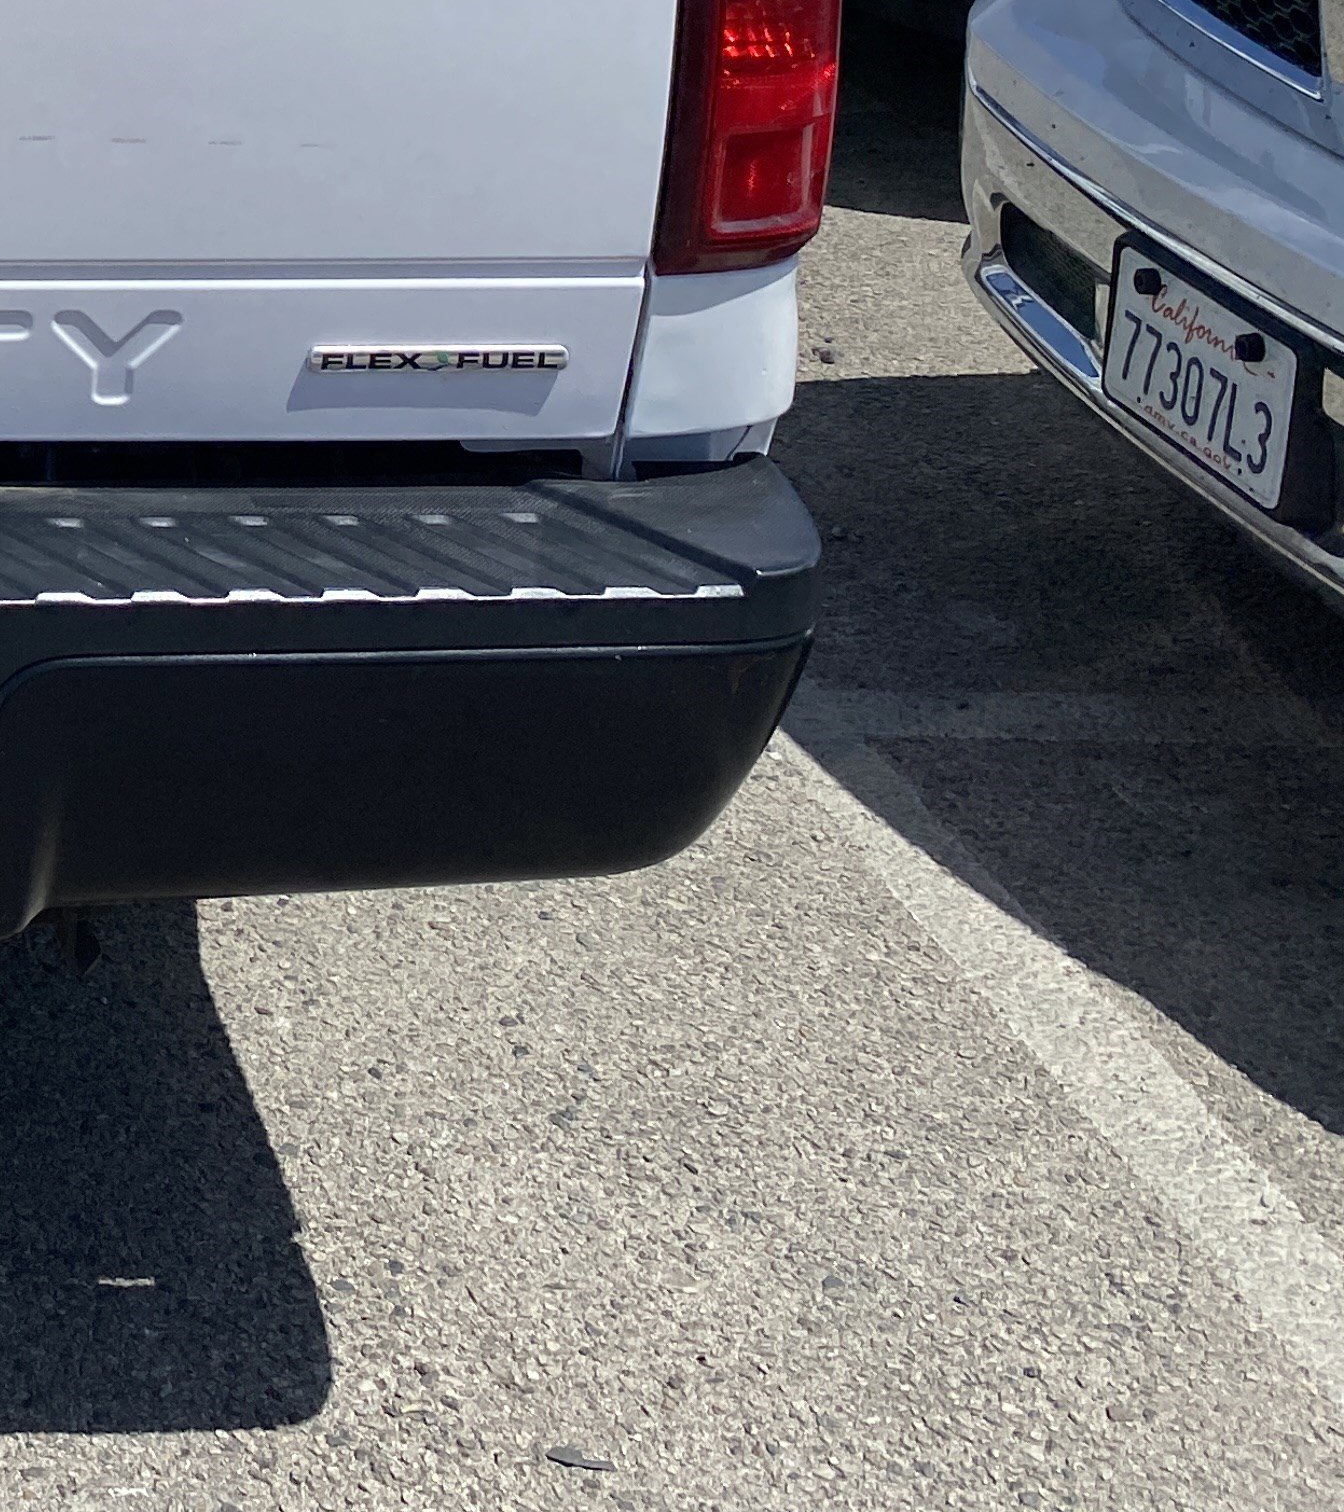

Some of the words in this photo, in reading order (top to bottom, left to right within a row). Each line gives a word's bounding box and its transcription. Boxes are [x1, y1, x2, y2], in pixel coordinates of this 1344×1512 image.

[320, 352, 423, 370] FLEX
[456, 351, 559, 370] FUEL
[1151, 284, 1260, 376] Californi
[1122, 309, 1273, 474] 77307L3
